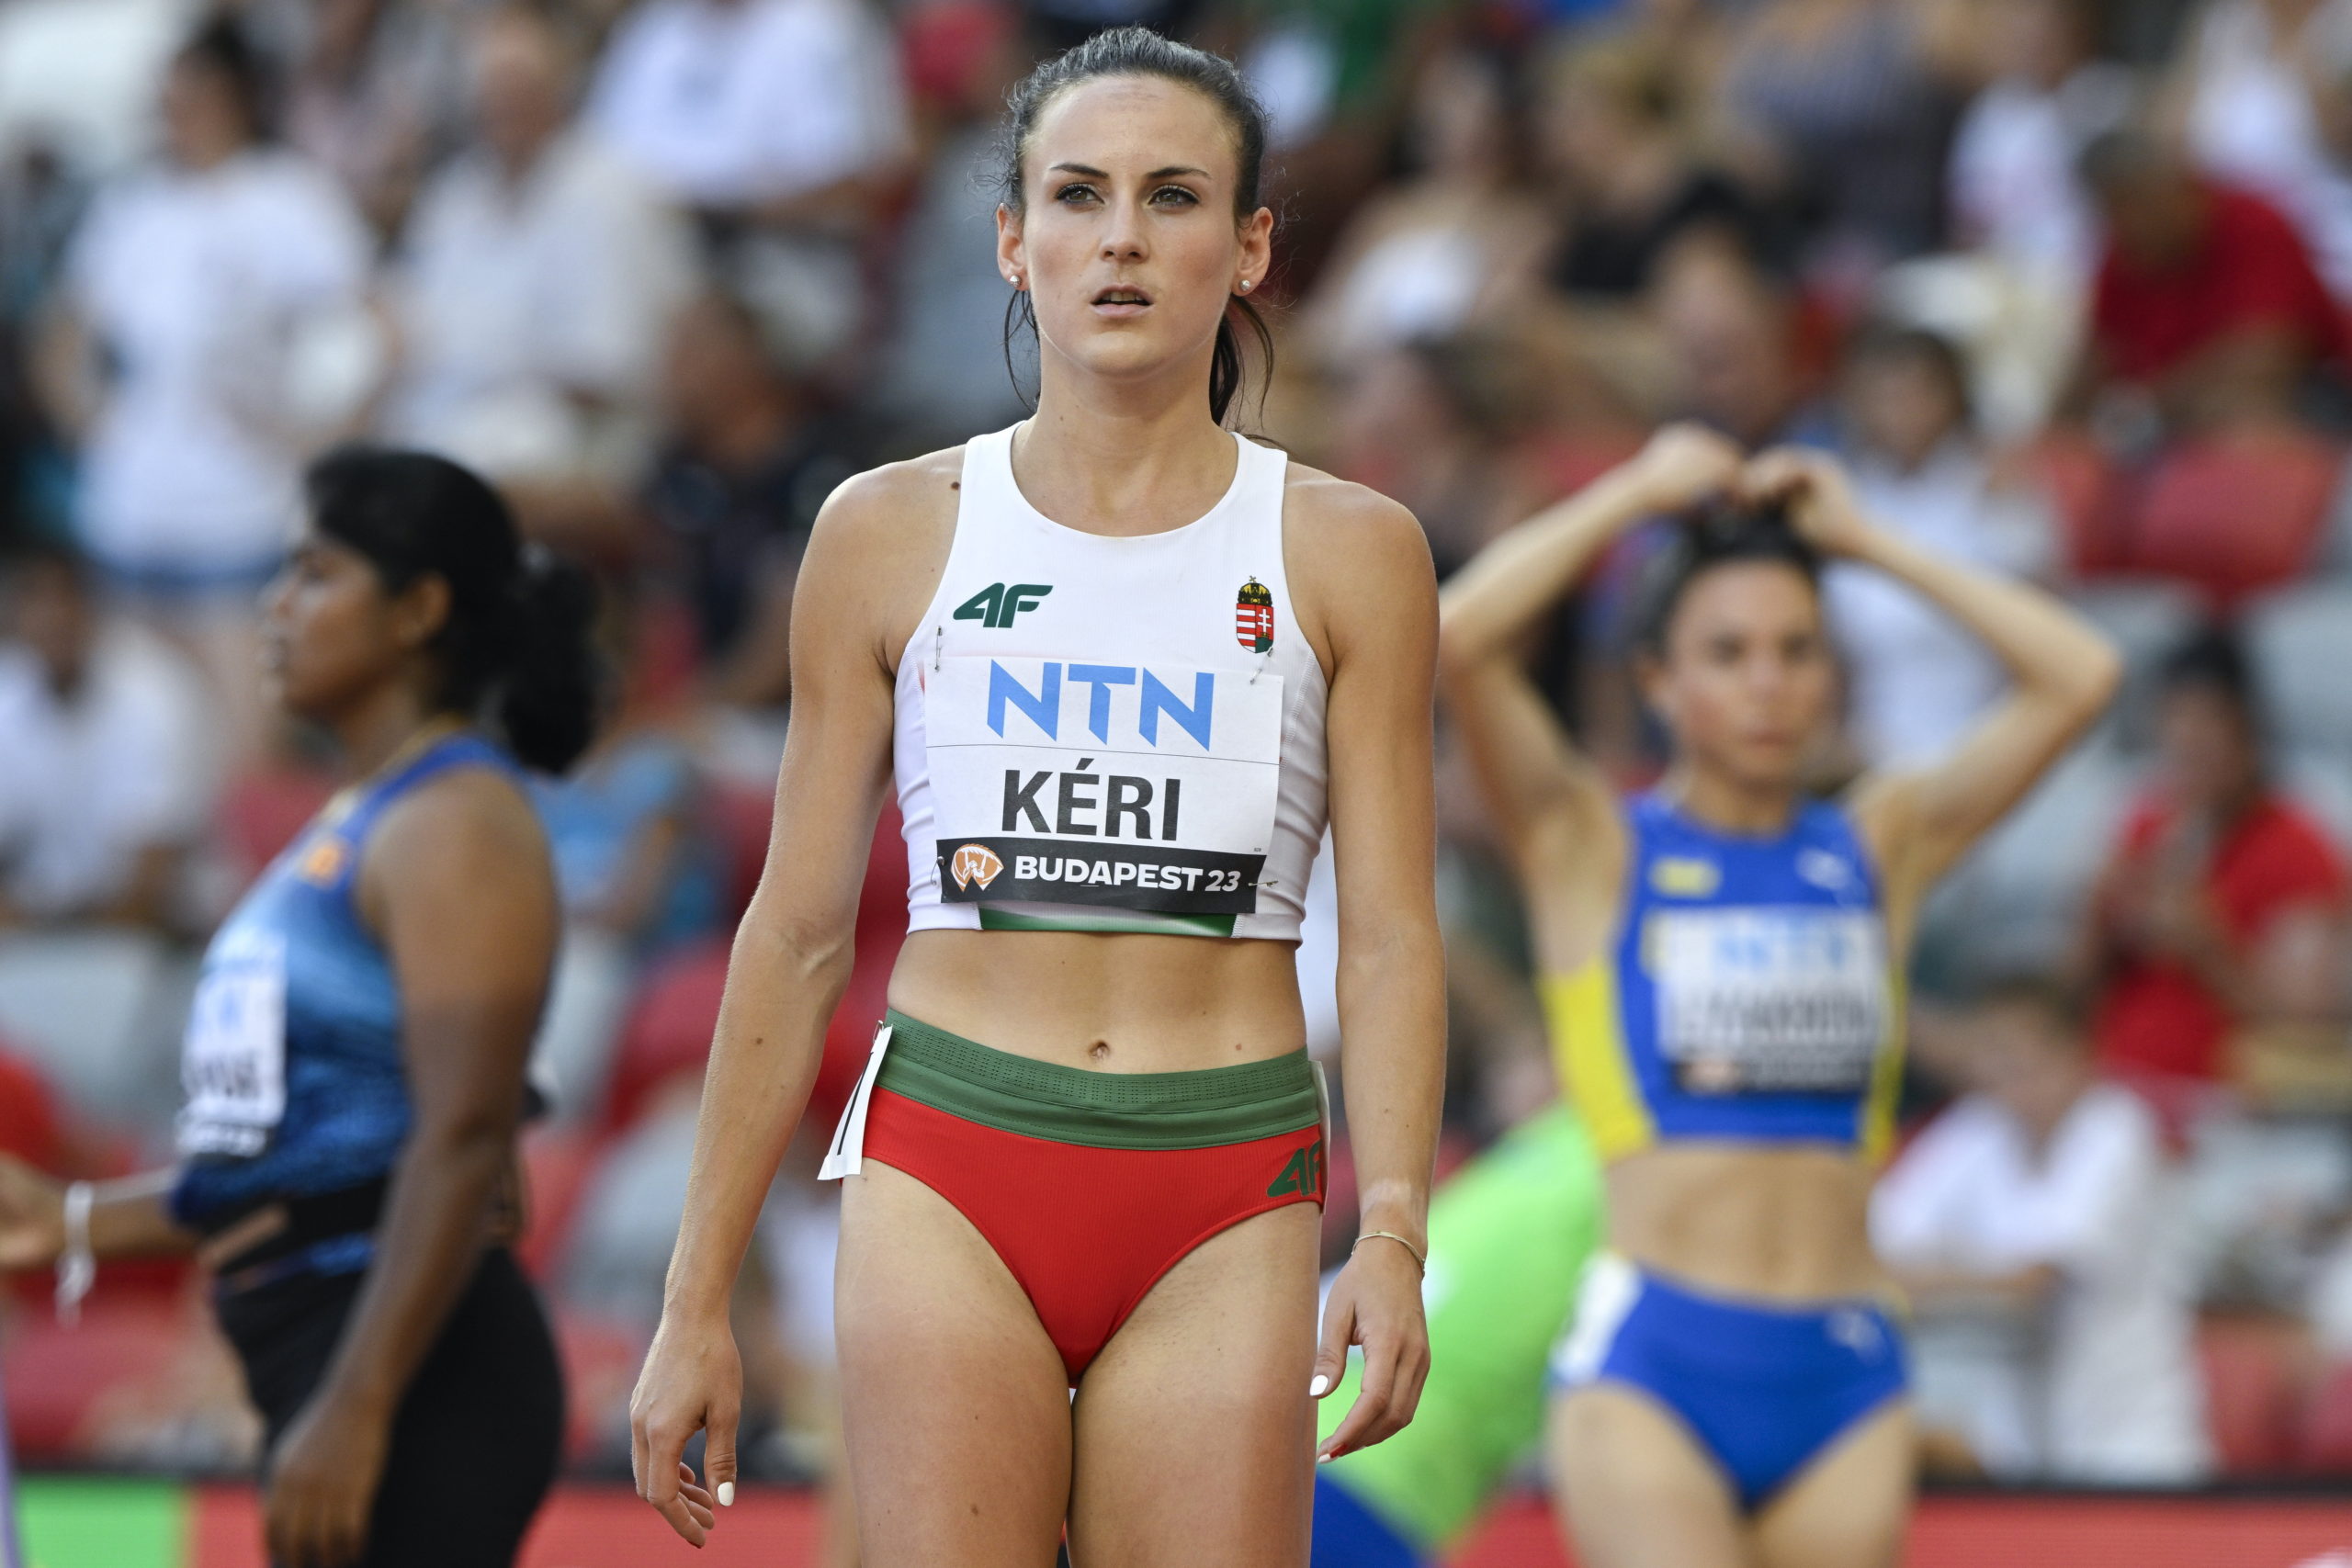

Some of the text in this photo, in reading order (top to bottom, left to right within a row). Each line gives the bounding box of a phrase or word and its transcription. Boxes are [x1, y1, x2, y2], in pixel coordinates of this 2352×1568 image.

[953, 582, 1054, 628] 4F
[987, 659, 1215, 751] NTN
[1001, 757, 1181, 841] KÉRI
[1014, 855, 1241, 892] BUDAPEST 23
